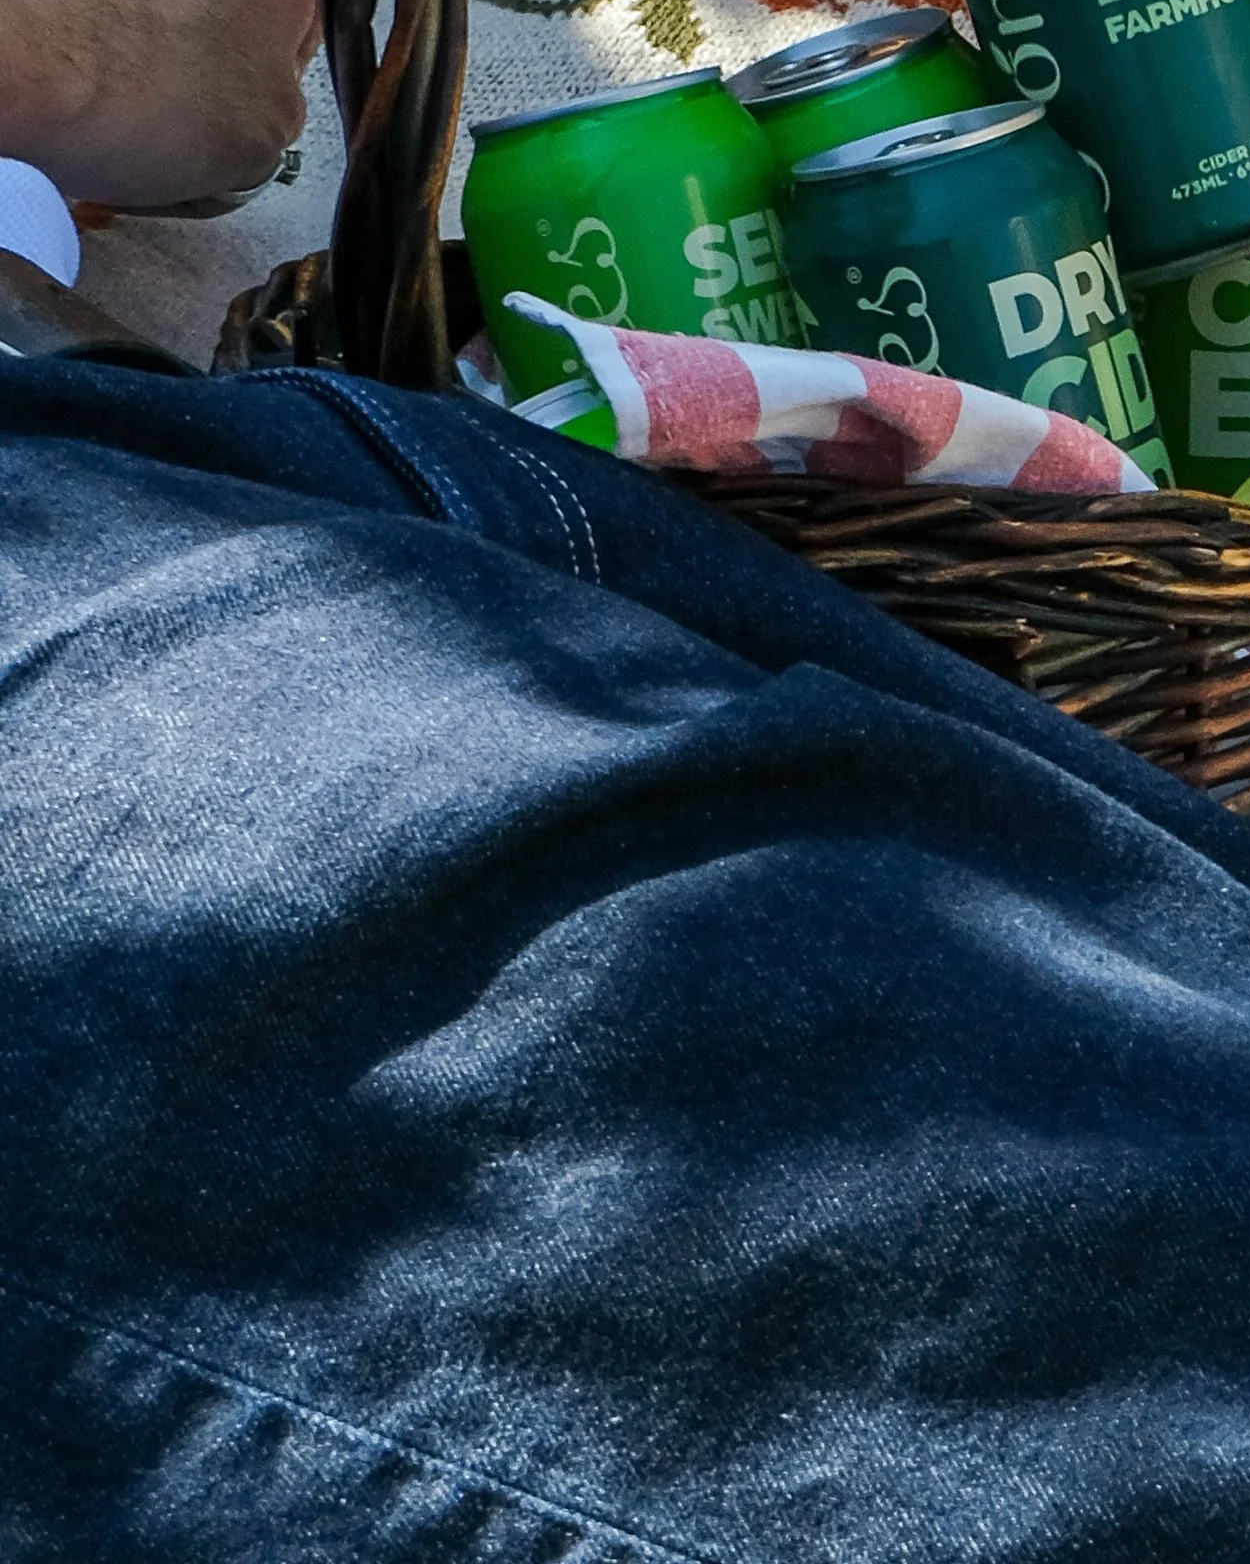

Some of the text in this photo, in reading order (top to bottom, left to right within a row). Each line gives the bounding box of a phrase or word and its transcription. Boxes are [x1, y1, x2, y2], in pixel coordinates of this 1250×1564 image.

[1198, 144, 1250, 174] CIDER
[1171, 173, 1229, 201] 473ML
[987, 234, 1127, 359] DRY
